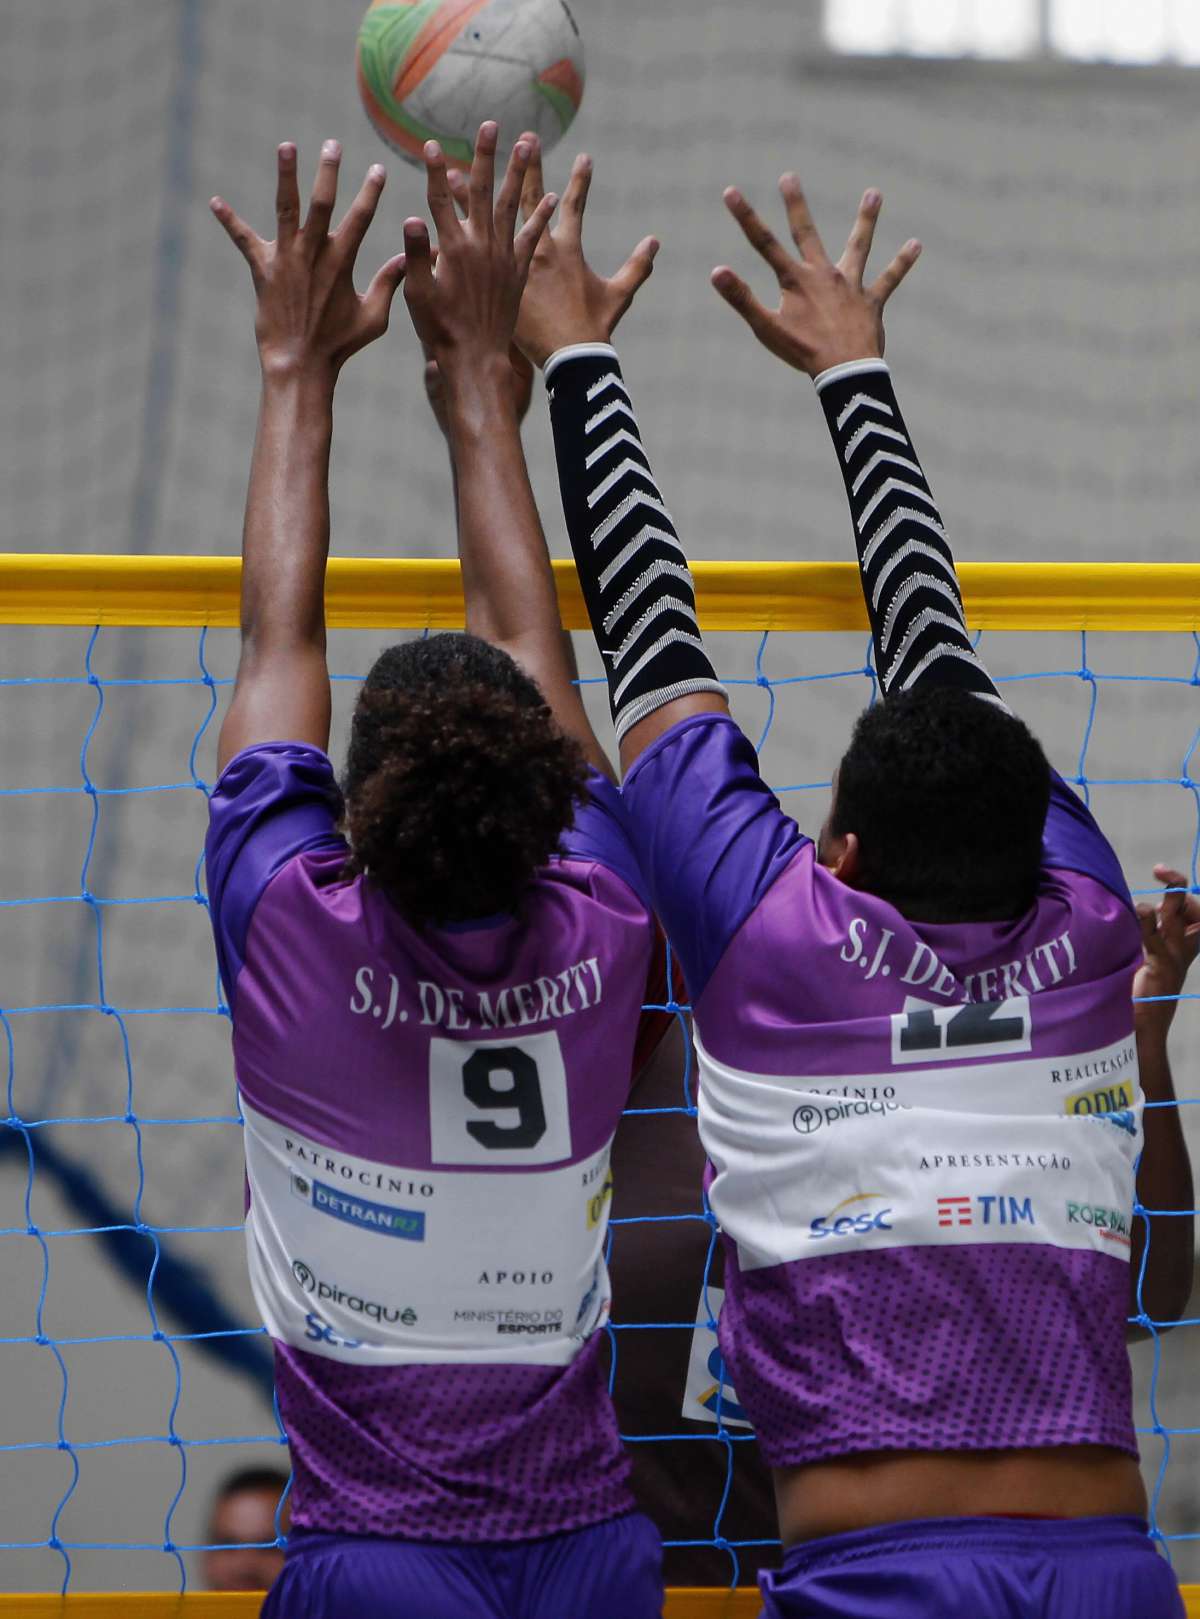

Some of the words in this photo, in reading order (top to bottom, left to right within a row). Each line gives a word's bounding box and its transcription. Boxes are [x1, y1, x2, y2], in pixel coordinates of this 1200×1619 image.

[840, 918, 895, 980] S.J.
[350, 967, 408, 1030] S.J.
[418, 981, 471, 1030] DE
[478, 957, 602, 1030] MERITI
[462, 1046, 547, 1150] 9
[284, 1139, 434, 1197] PATROCÍNIO
[919, 1153, 1071, 1171] APRESENTAÇÃO
[977, 1196, 1035, 1225] TIM
[478, 1272, 553, 1285] APOIO
[318, 1281, 418, 1326] piraquê
[497, 1322, 562, 1334] ESPORTE
